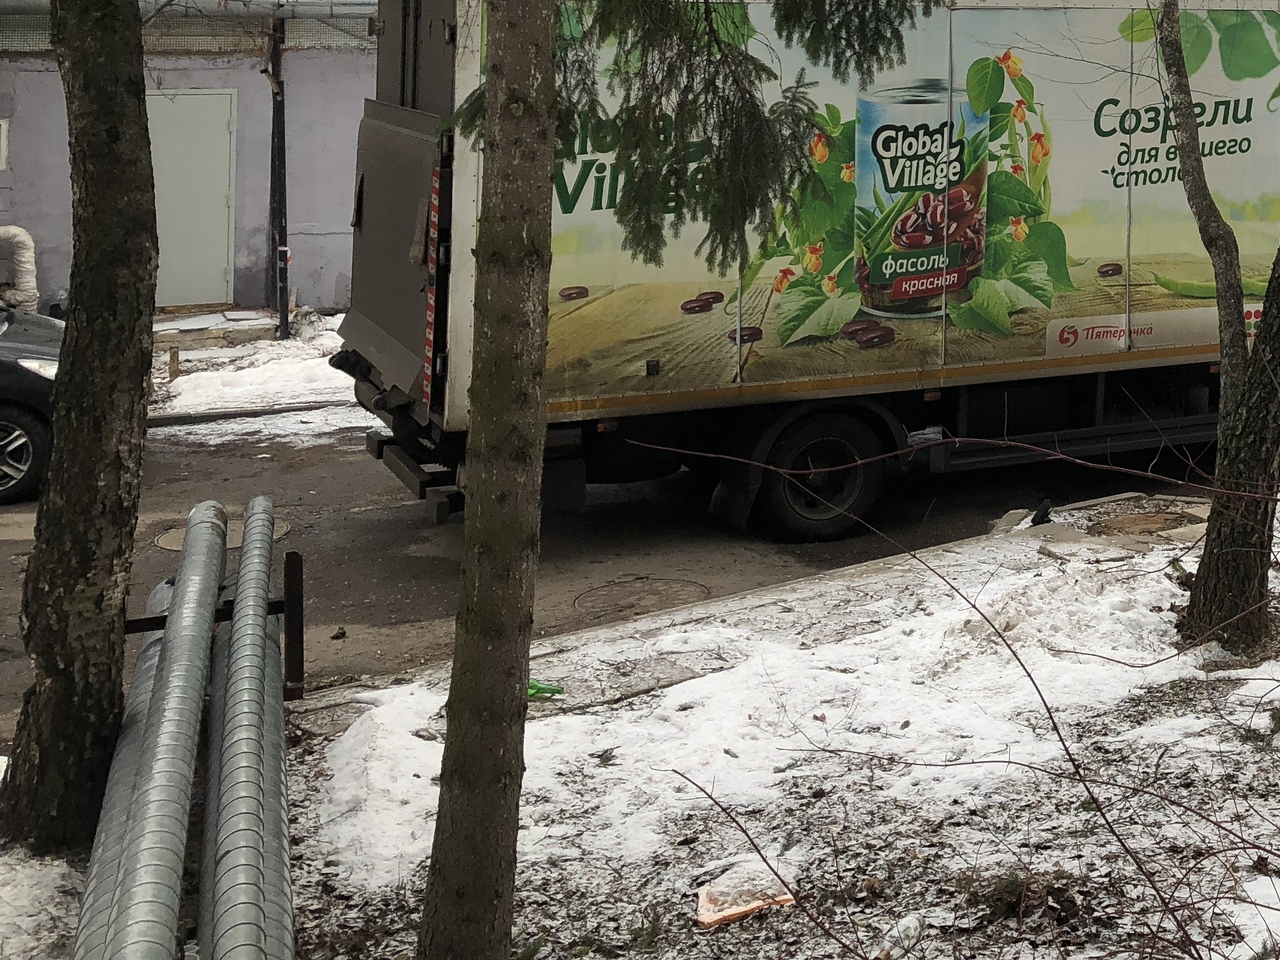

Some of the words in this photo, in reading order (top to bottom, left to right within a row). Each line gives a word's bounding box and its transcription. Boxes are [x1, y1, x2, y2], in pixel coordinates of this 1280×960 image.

[876, 127, 949, 158] Global
[1117, 142, 1159, 166] для
[1165, 137, 1252, 161] вшего
[882, 158, 960, 189] Village
[882, 254, 949, 278] фасоль
[902, 273, 958, 294] красная
